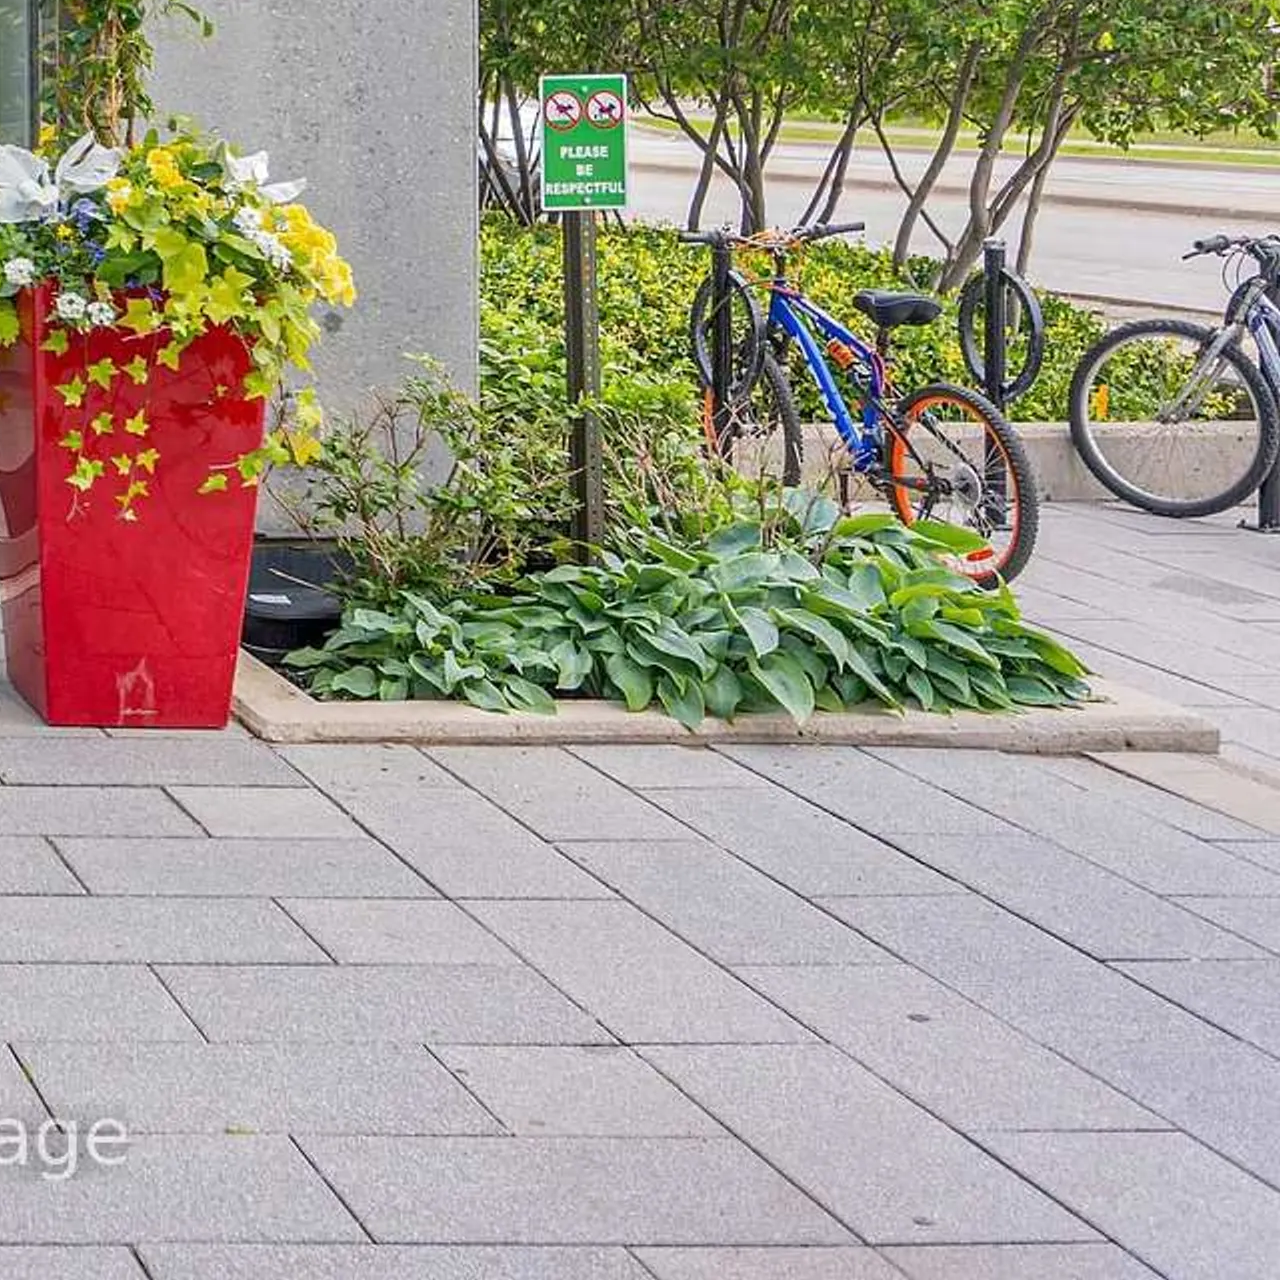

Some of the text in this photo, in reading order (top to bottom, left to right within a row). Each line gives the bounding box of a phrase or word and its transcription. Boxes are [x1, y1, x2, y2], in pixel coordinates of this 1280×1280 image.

[559, 145, 609, 159] PLEASE
[575, 164, 594, 177] BE
[545, 181, 625, 195] RESPECTFUL
